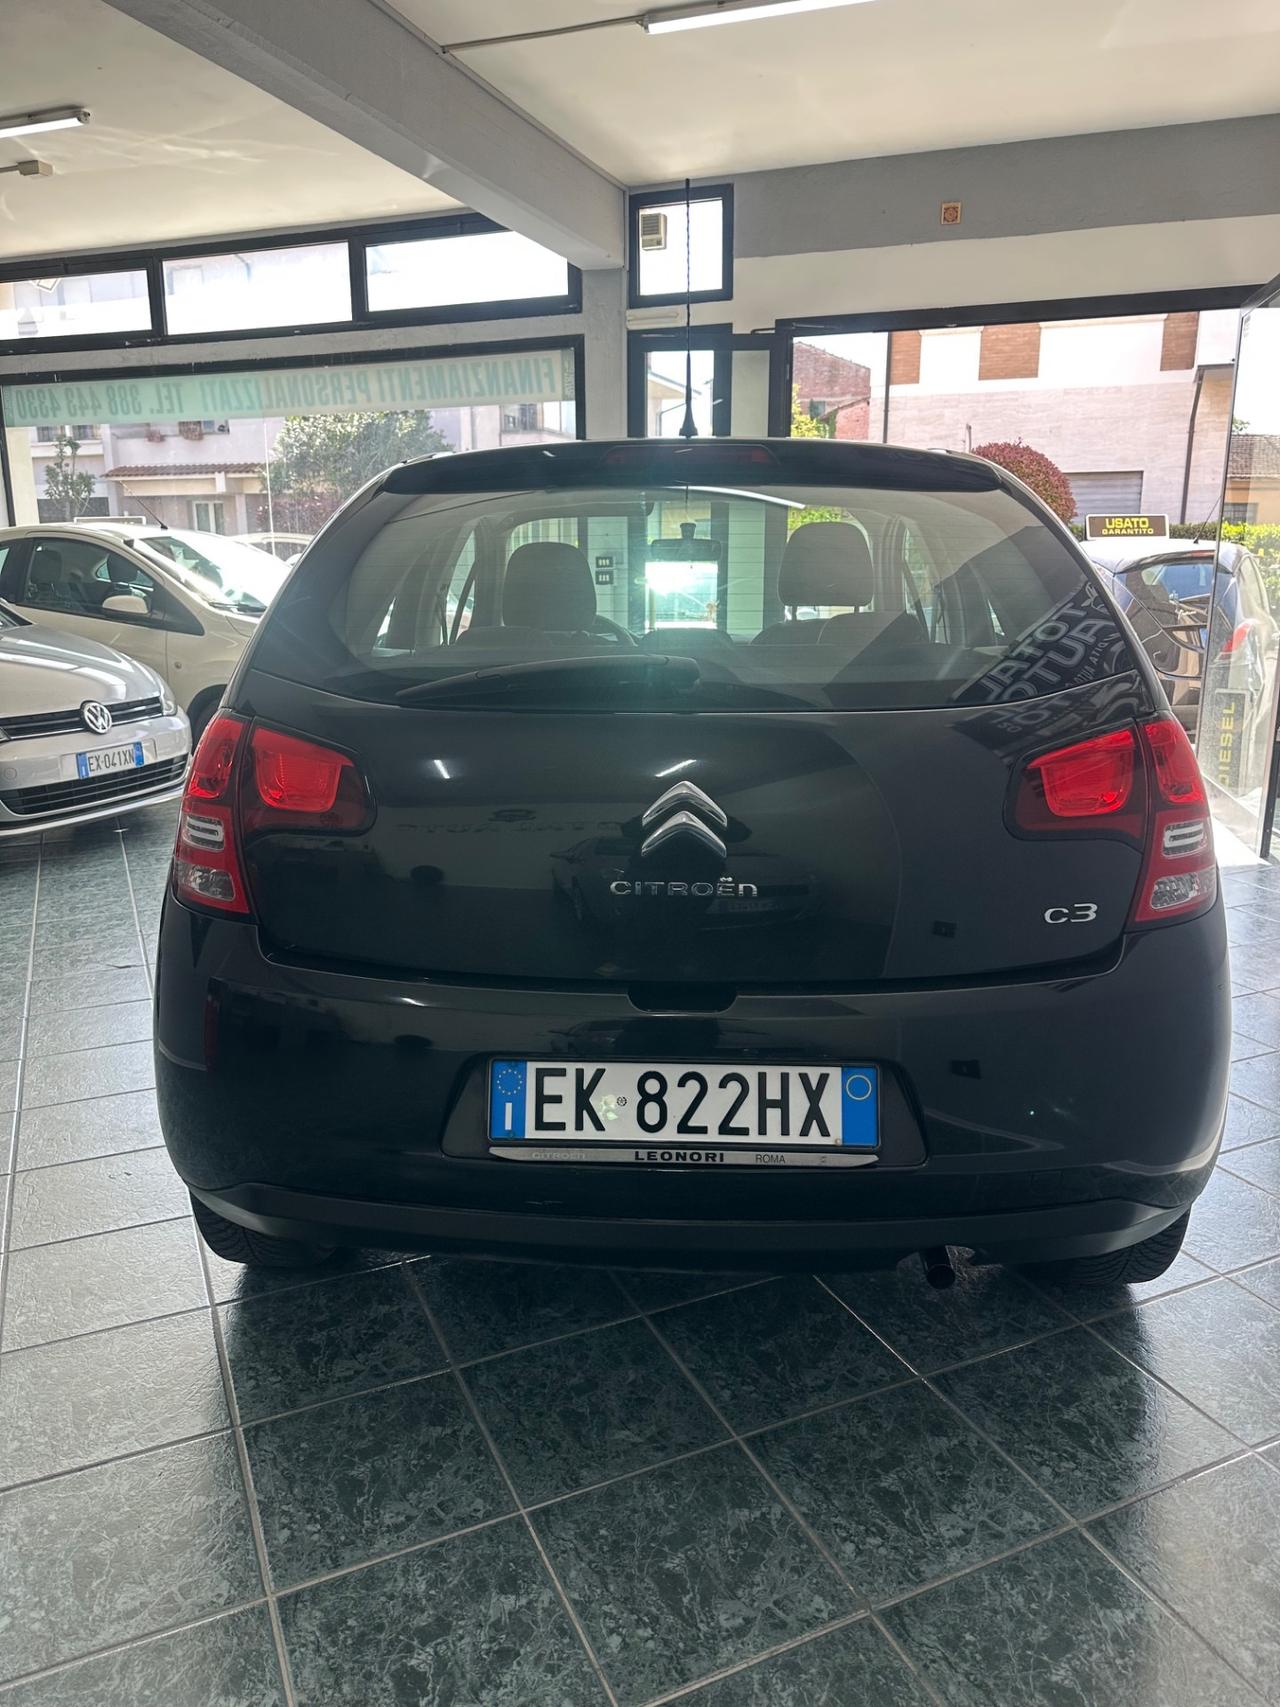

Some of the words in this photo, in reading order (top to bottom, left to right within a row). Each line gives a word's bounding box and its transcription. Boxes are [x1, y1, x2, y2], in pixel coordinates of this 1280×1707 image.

[1105, 517, 1149, 529] USATO
[1217, 702, 1236, 786] DIESEL
[534, 1067, 606, 1132] EK
[636, 1070, 832, 1138] 822HX
[634, 1150, 725, 1163] LEONORI
[755, 1153, 786, 1165] ROMA
